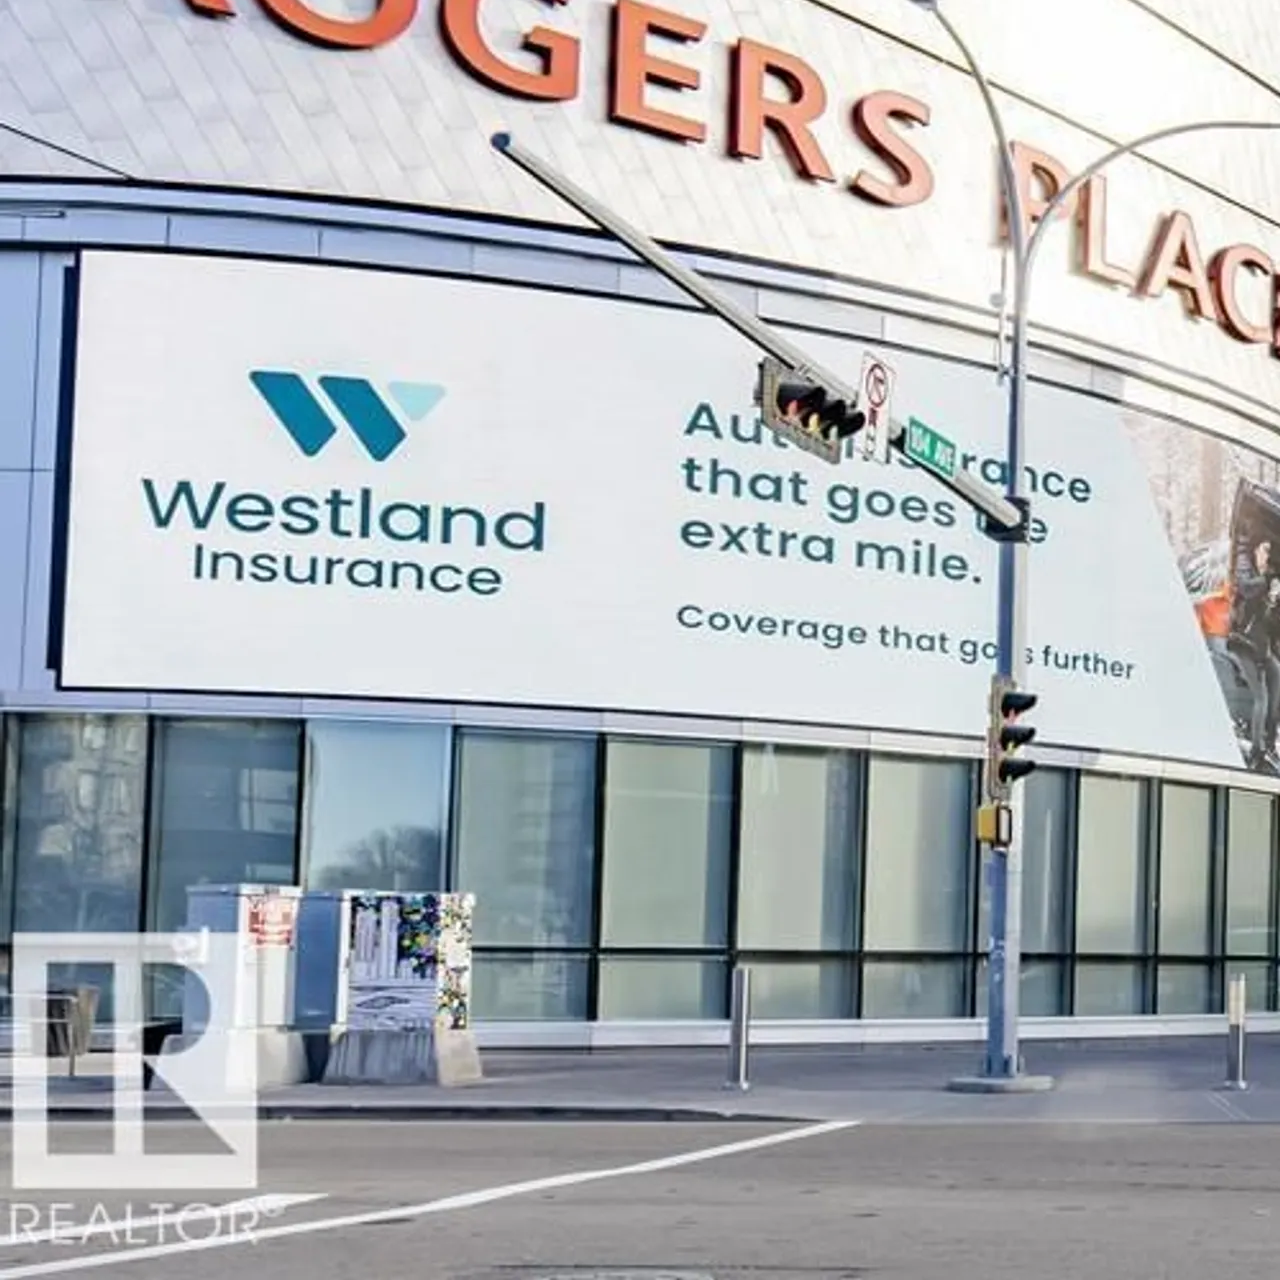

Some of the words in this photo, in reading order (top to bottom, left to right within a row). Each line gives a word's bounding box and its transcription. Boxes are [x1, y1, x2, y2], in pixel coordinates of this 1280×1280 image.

[142, 477, 546, 552] Westland
[682, 455, 808, 506] that
[827, 482, 956, 527] goes
[193, 543, 502, 595] Insurance
[680, 520, 835, 564] extra
[854, 538, 983, 584] mile.
[676, 604, 867, 649] Coverage
[879, 625, 949, 655] that
[960, 638, 1033, 665] gos
[1042, 644, 1135, 680] further
